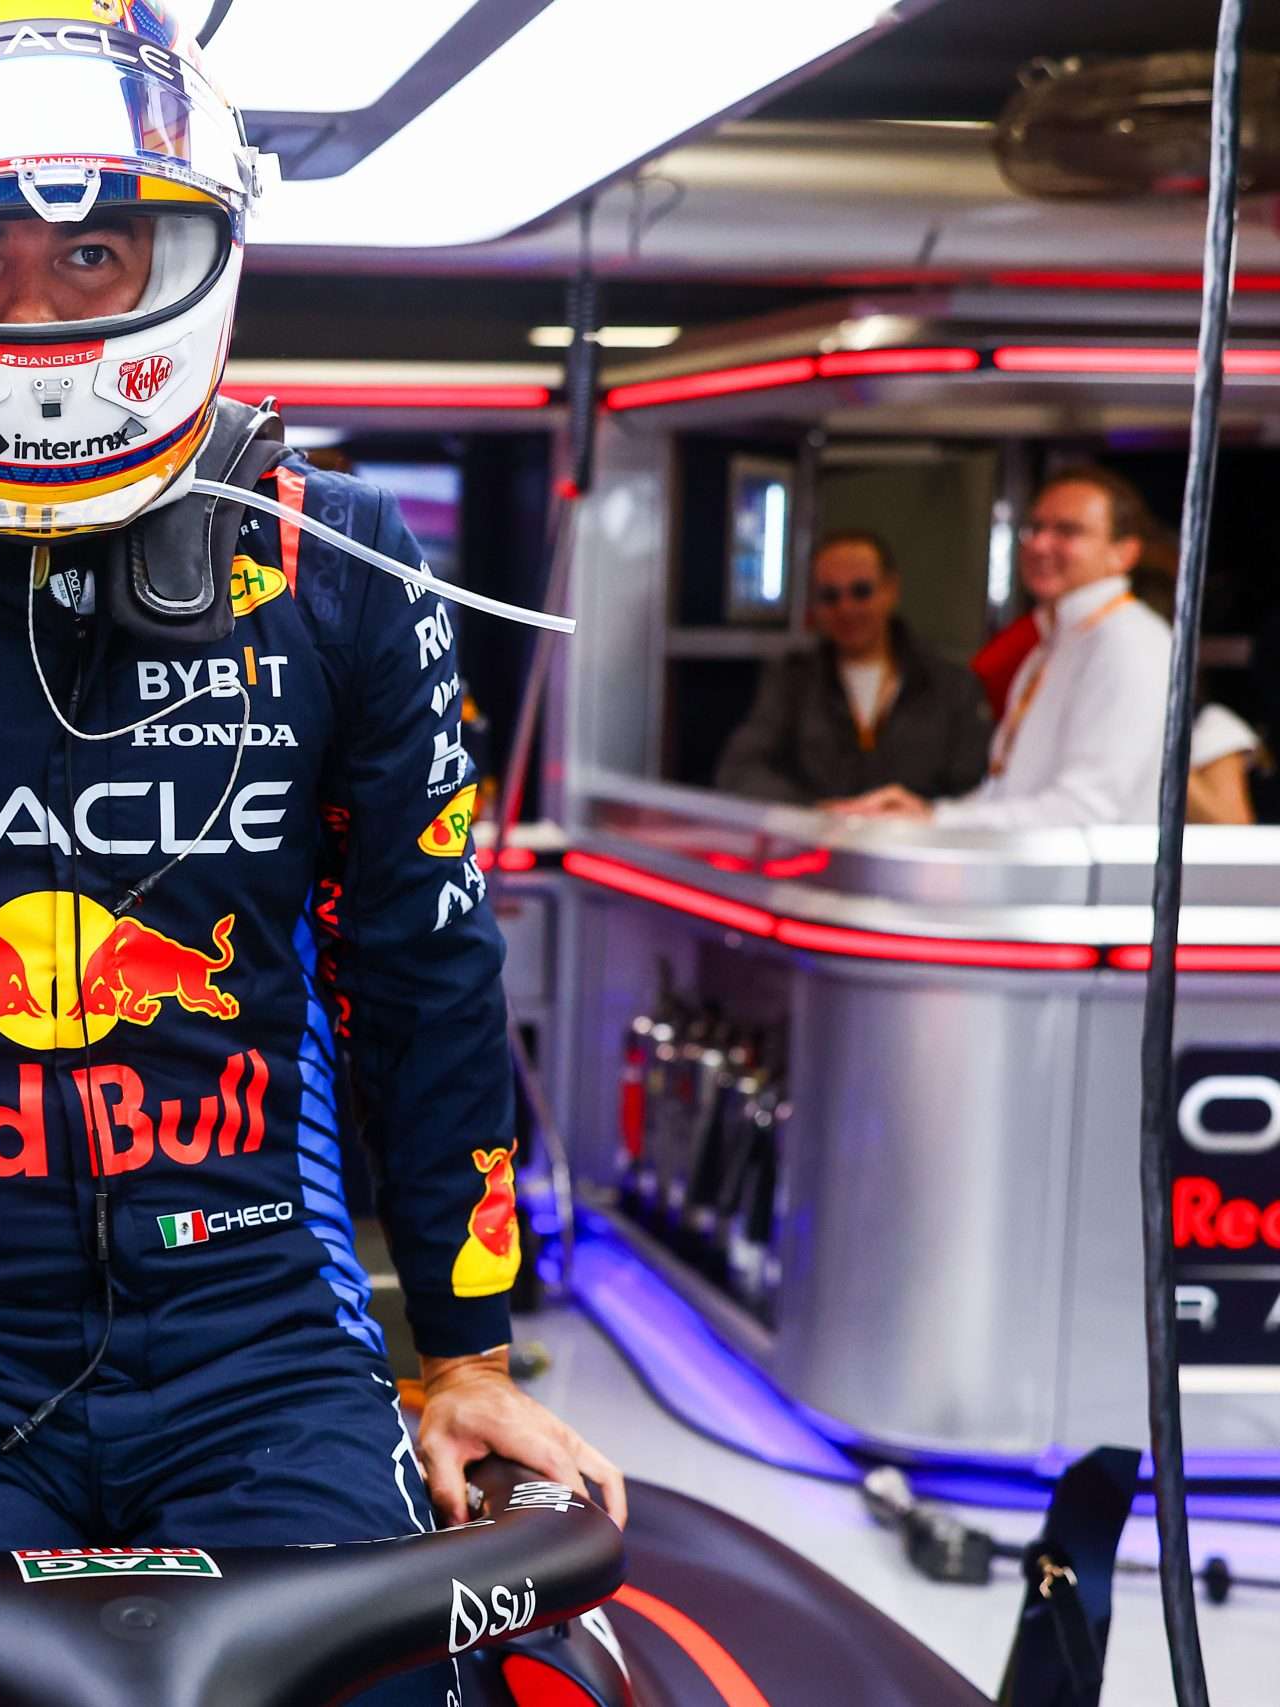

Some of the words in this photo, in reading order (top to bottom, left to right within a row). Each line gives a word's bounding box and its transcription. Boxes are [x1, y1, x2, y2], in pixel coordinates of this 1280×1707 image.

[17, 350, 97, 366] BANORTE
[125, 357, 171, 400] KitKat
[14, 427, 131, 460] inter.mx
[136, 646, 289, 701] BYBIT
[131, 723, 298, 747] HONDA
[71, 1048, 270, 1178] Bull
[207, 1201, 294, 1234] CHECO
[36, 1556, 203, 1574] TAG
[487, 1577, 536, 1637] Sui
